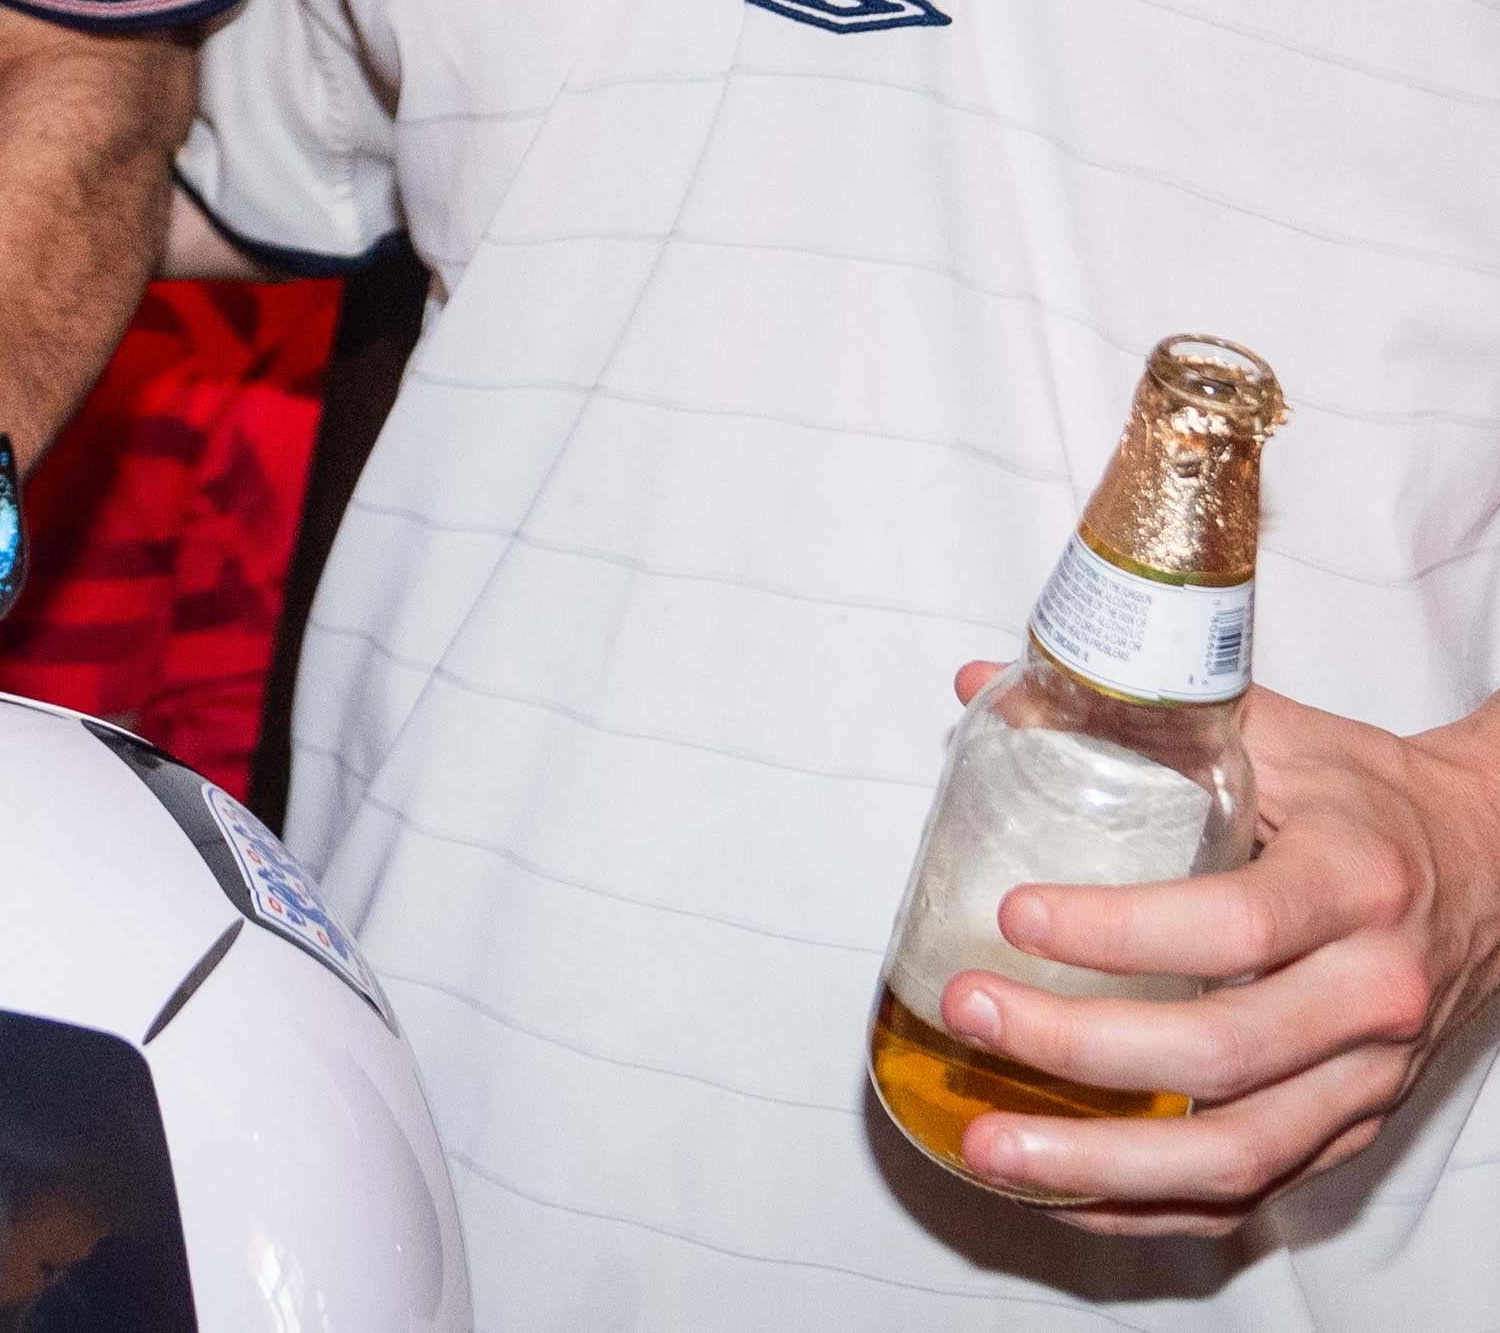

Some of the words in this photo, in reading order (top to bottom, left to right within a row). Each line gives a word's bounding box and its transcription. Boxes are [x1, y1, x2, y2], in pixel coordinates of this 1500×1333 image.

[1103, 591, 1151, 617] ALCOHOLIC
[1097, 615, 1145, 641] ALCOHOLIC
[1128, 639, 1143, 654] OR
